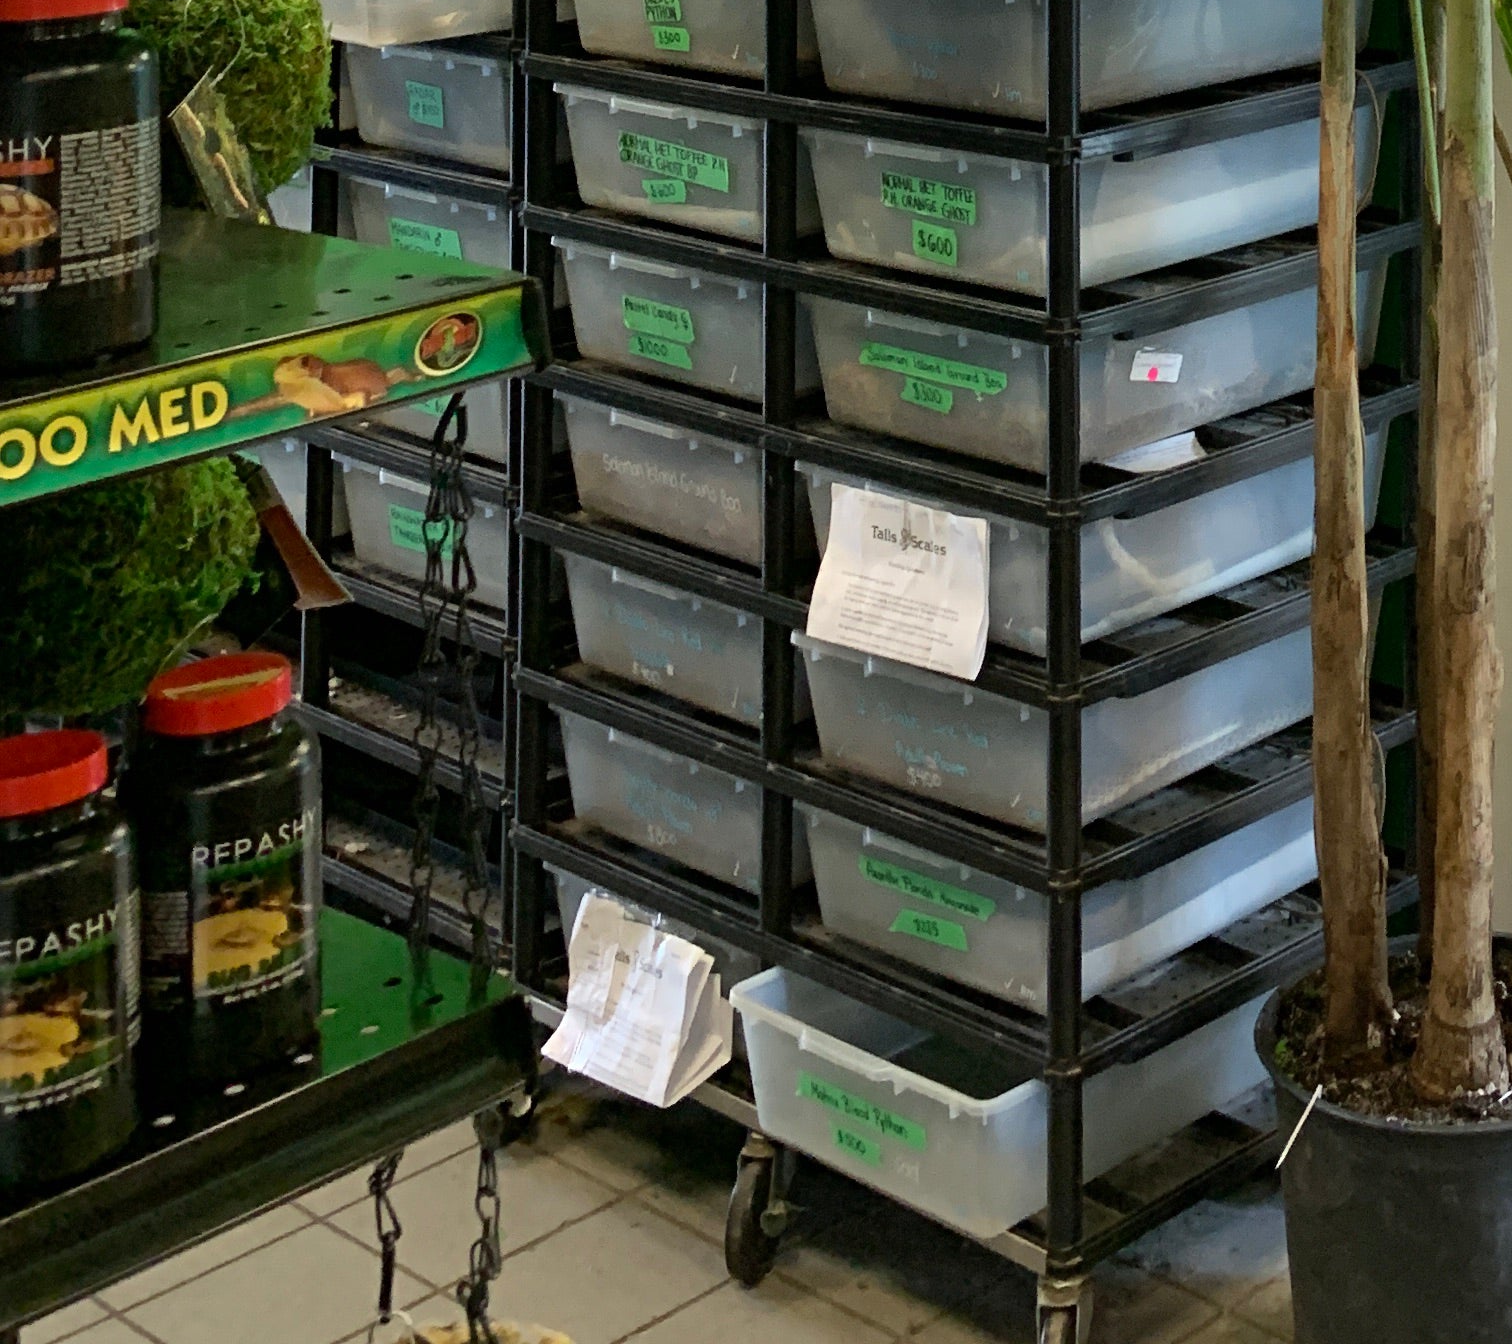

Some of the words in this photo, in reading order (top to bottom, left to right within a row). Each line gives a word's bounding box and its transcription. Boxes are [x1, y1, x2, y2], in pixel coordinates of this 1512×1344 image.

[941, 202, 971, 225] GHOST
[917, 229, 953, 257] $600
[0, 415, 88, 481] OO
[108, 380, 229, 454] MED
[910, 535, 947, 556] Scales
[0, 910, 119, 962] EPASHY
